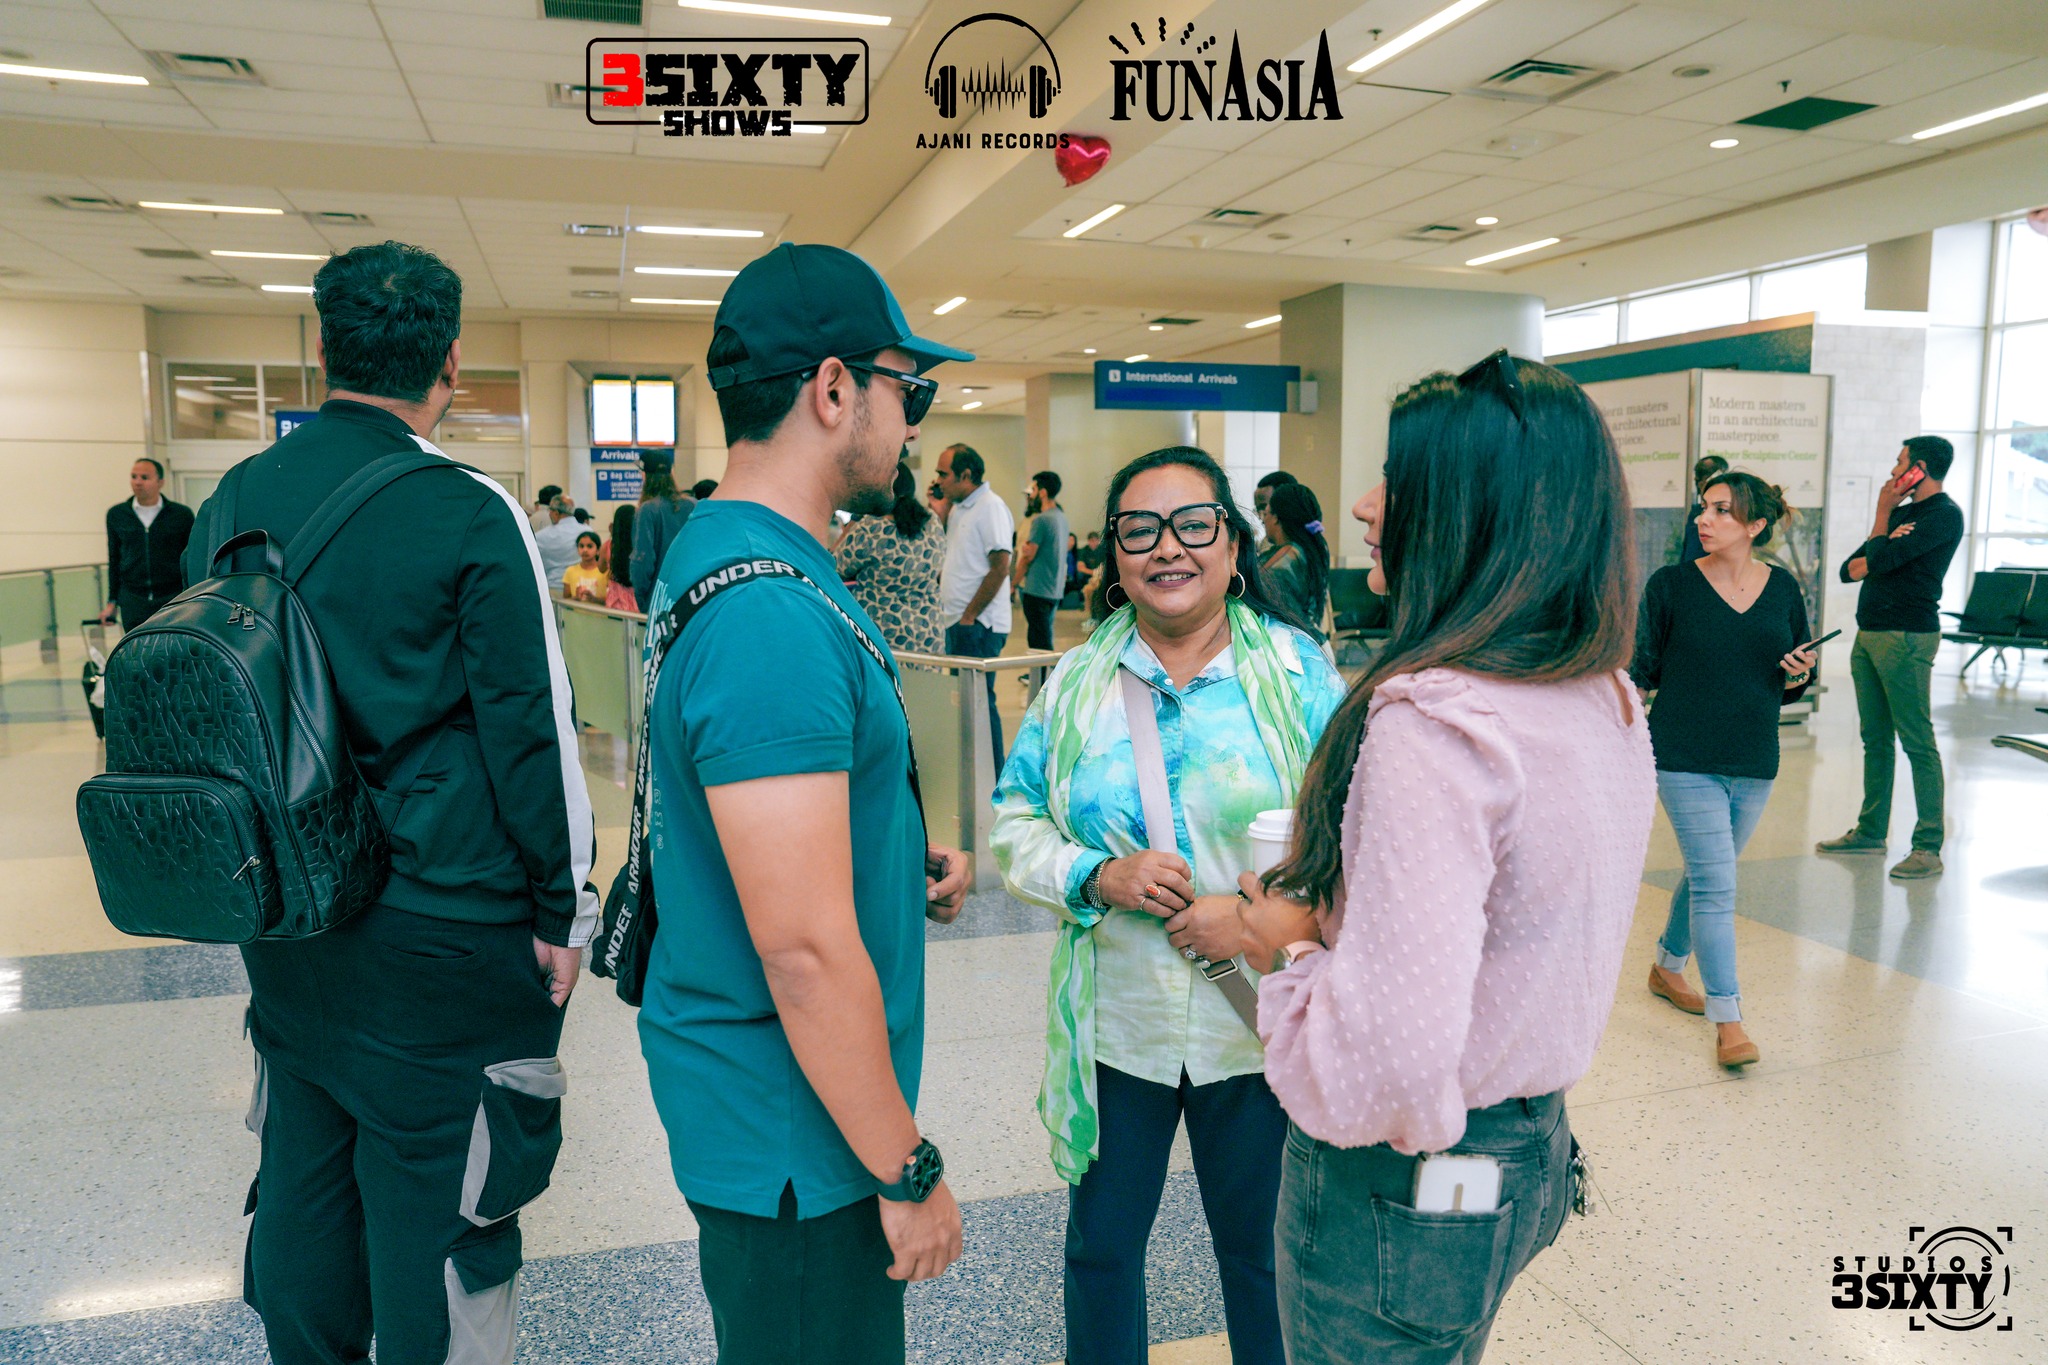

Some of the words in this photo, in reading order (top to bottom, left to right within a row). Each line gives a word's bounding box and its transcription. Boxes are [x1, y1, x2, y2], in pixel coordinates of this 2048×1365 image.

[1126, 371, 1194, 384] International
[1198, 373, 1238, 385] Arrivals
[1627, 402, 1669, 415] masters
[1708, 397, 1756, 410] Modern
[1759, 399, 1806, 411] masters
[1708, 414, 1720, 425] in
[1724, 416, 1740, 426] an
[1742, 414, 1819, 428] architectural
[601, 450, 640, 460] Arrivals
[1653, 451, 1681, 462] Center
[1788, 450, 1817, 461] Center
[689, 560, 796, 605] UNDER
[628, 805, 642, 895] ARMOUR
